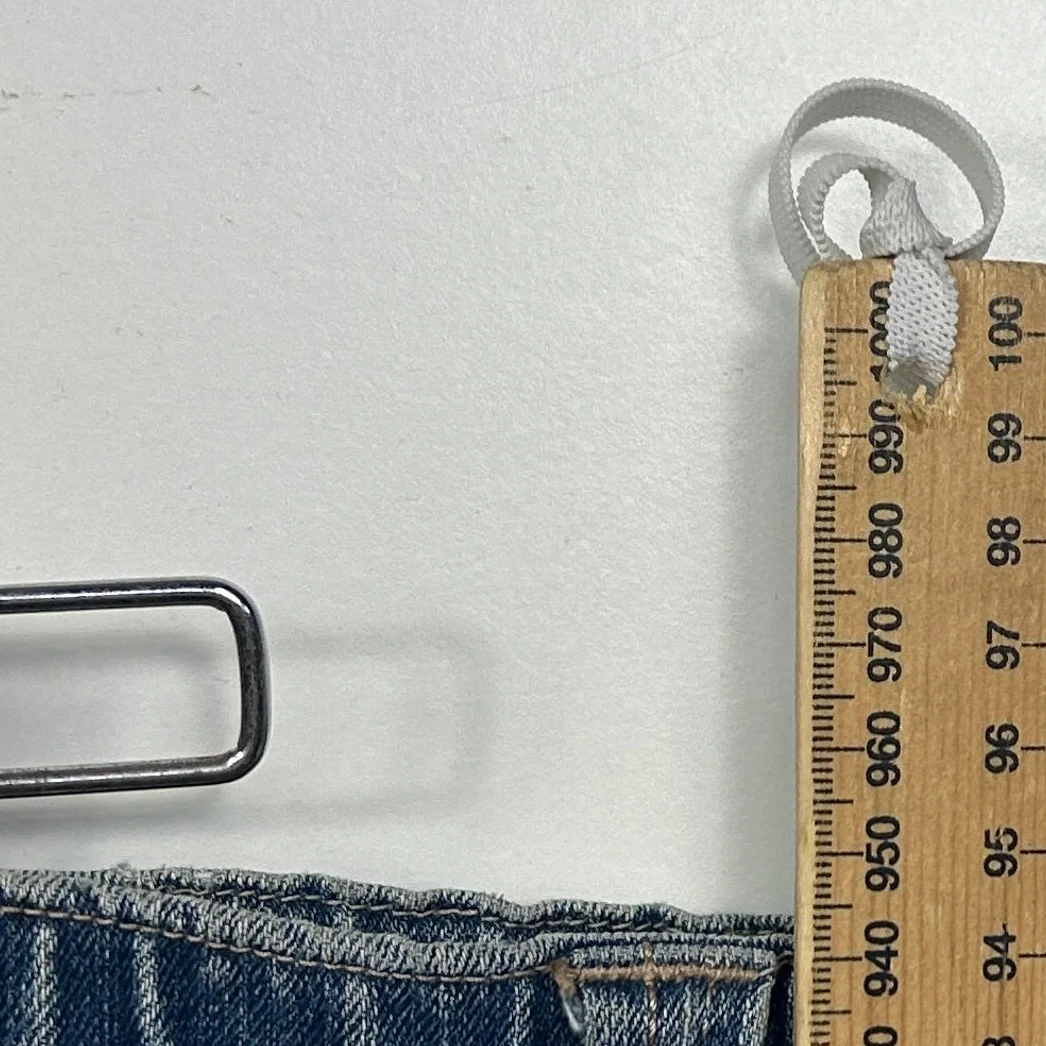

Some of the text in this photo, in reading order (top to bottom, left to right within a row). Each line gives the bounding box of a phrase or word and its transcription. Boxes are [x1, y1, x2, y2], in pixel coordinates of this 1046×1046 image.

[988, 296, 1023, 371] 100
[868, 399, 904, 475] 990
[987, 413, 1023, 464] 99
[868, 503, 903, 578] 980
[987, 516, 1022, 568] 98
[867, 607, 902, 684] 970
[985, 621, 1020, 670] 97
[866, 710, 901, 788] 960
[985, 723, 1020, 776] 96
[865, 816, 900, 893] 950
[983, 828, 1019, 877] 95
[864, 921, 899, 997] 940
[983, 925, 1017, 982] 94
